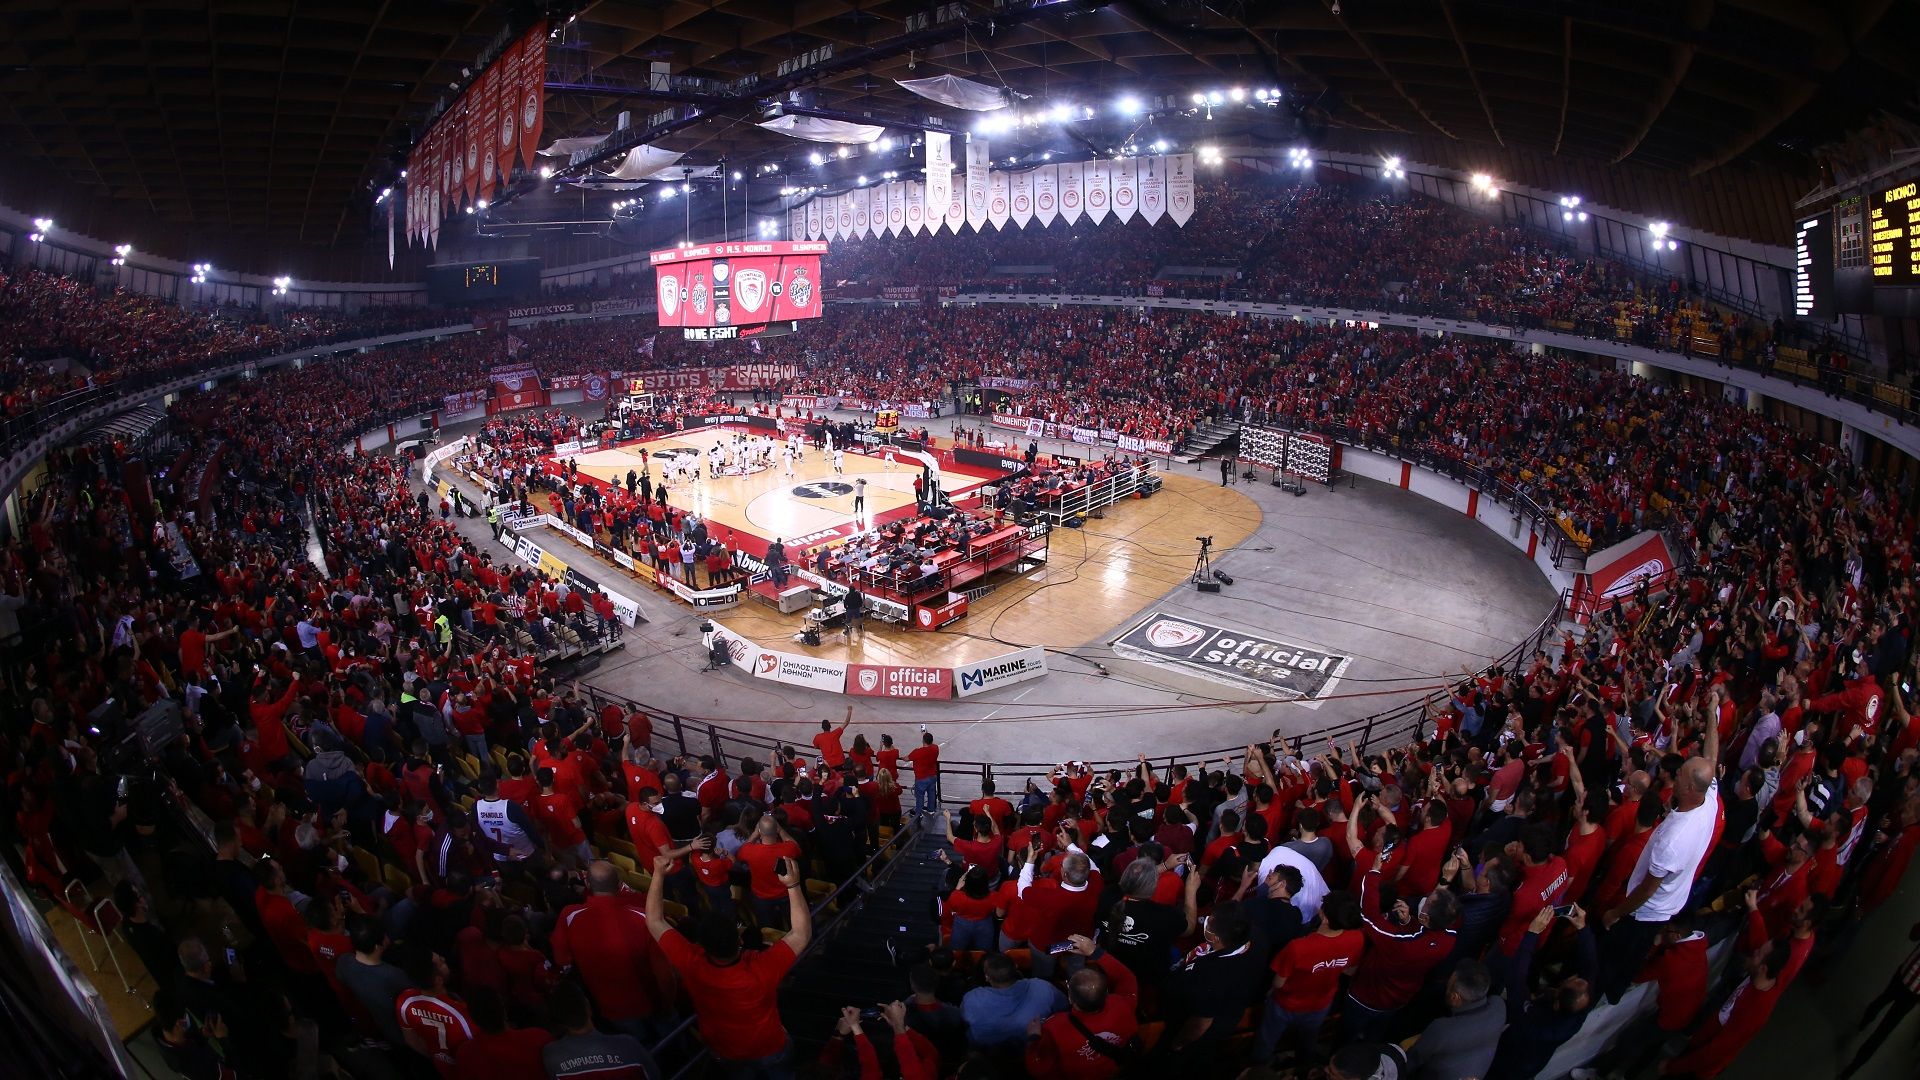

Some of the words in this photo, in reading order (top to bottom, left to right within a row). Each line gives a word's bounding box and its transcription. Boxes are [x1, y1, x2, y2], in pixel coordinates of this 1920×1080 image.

[743, 244, 772, 252] MONACO
[509, 303, 574, 318] ΝΑΥΠΑΚΤΟΣ
[624, 374, 700, 391] MSFITS
[887, 417, 897, 426] 24
[903, 410, 930, 418] LIOSIA
[1001, 459, 1017, 472] every
[500, 529, 516, 551] bwin
[518, 538, 541, 565] FMS
[1217, 637, 1329, 676] official
[783, 660, 811, 672] ΟΜΙΛΟΣ
[811, 665, 844, 678] ΙΑΤΡΙΚΟΥ
[889, 668, 941, 684] official
[982, 659, 1026, 678] MARINE
[889, 683, 928, 697] store
[1311, 957, 1349, 973] FMS
[411, 1007, 453, 1025] GALLETTI
[421, 1017, 448, 1050] 7
[560, 1054, 605, 1072] OLYMPIACOS
[607, 1054, 624, 1064] B.C.
